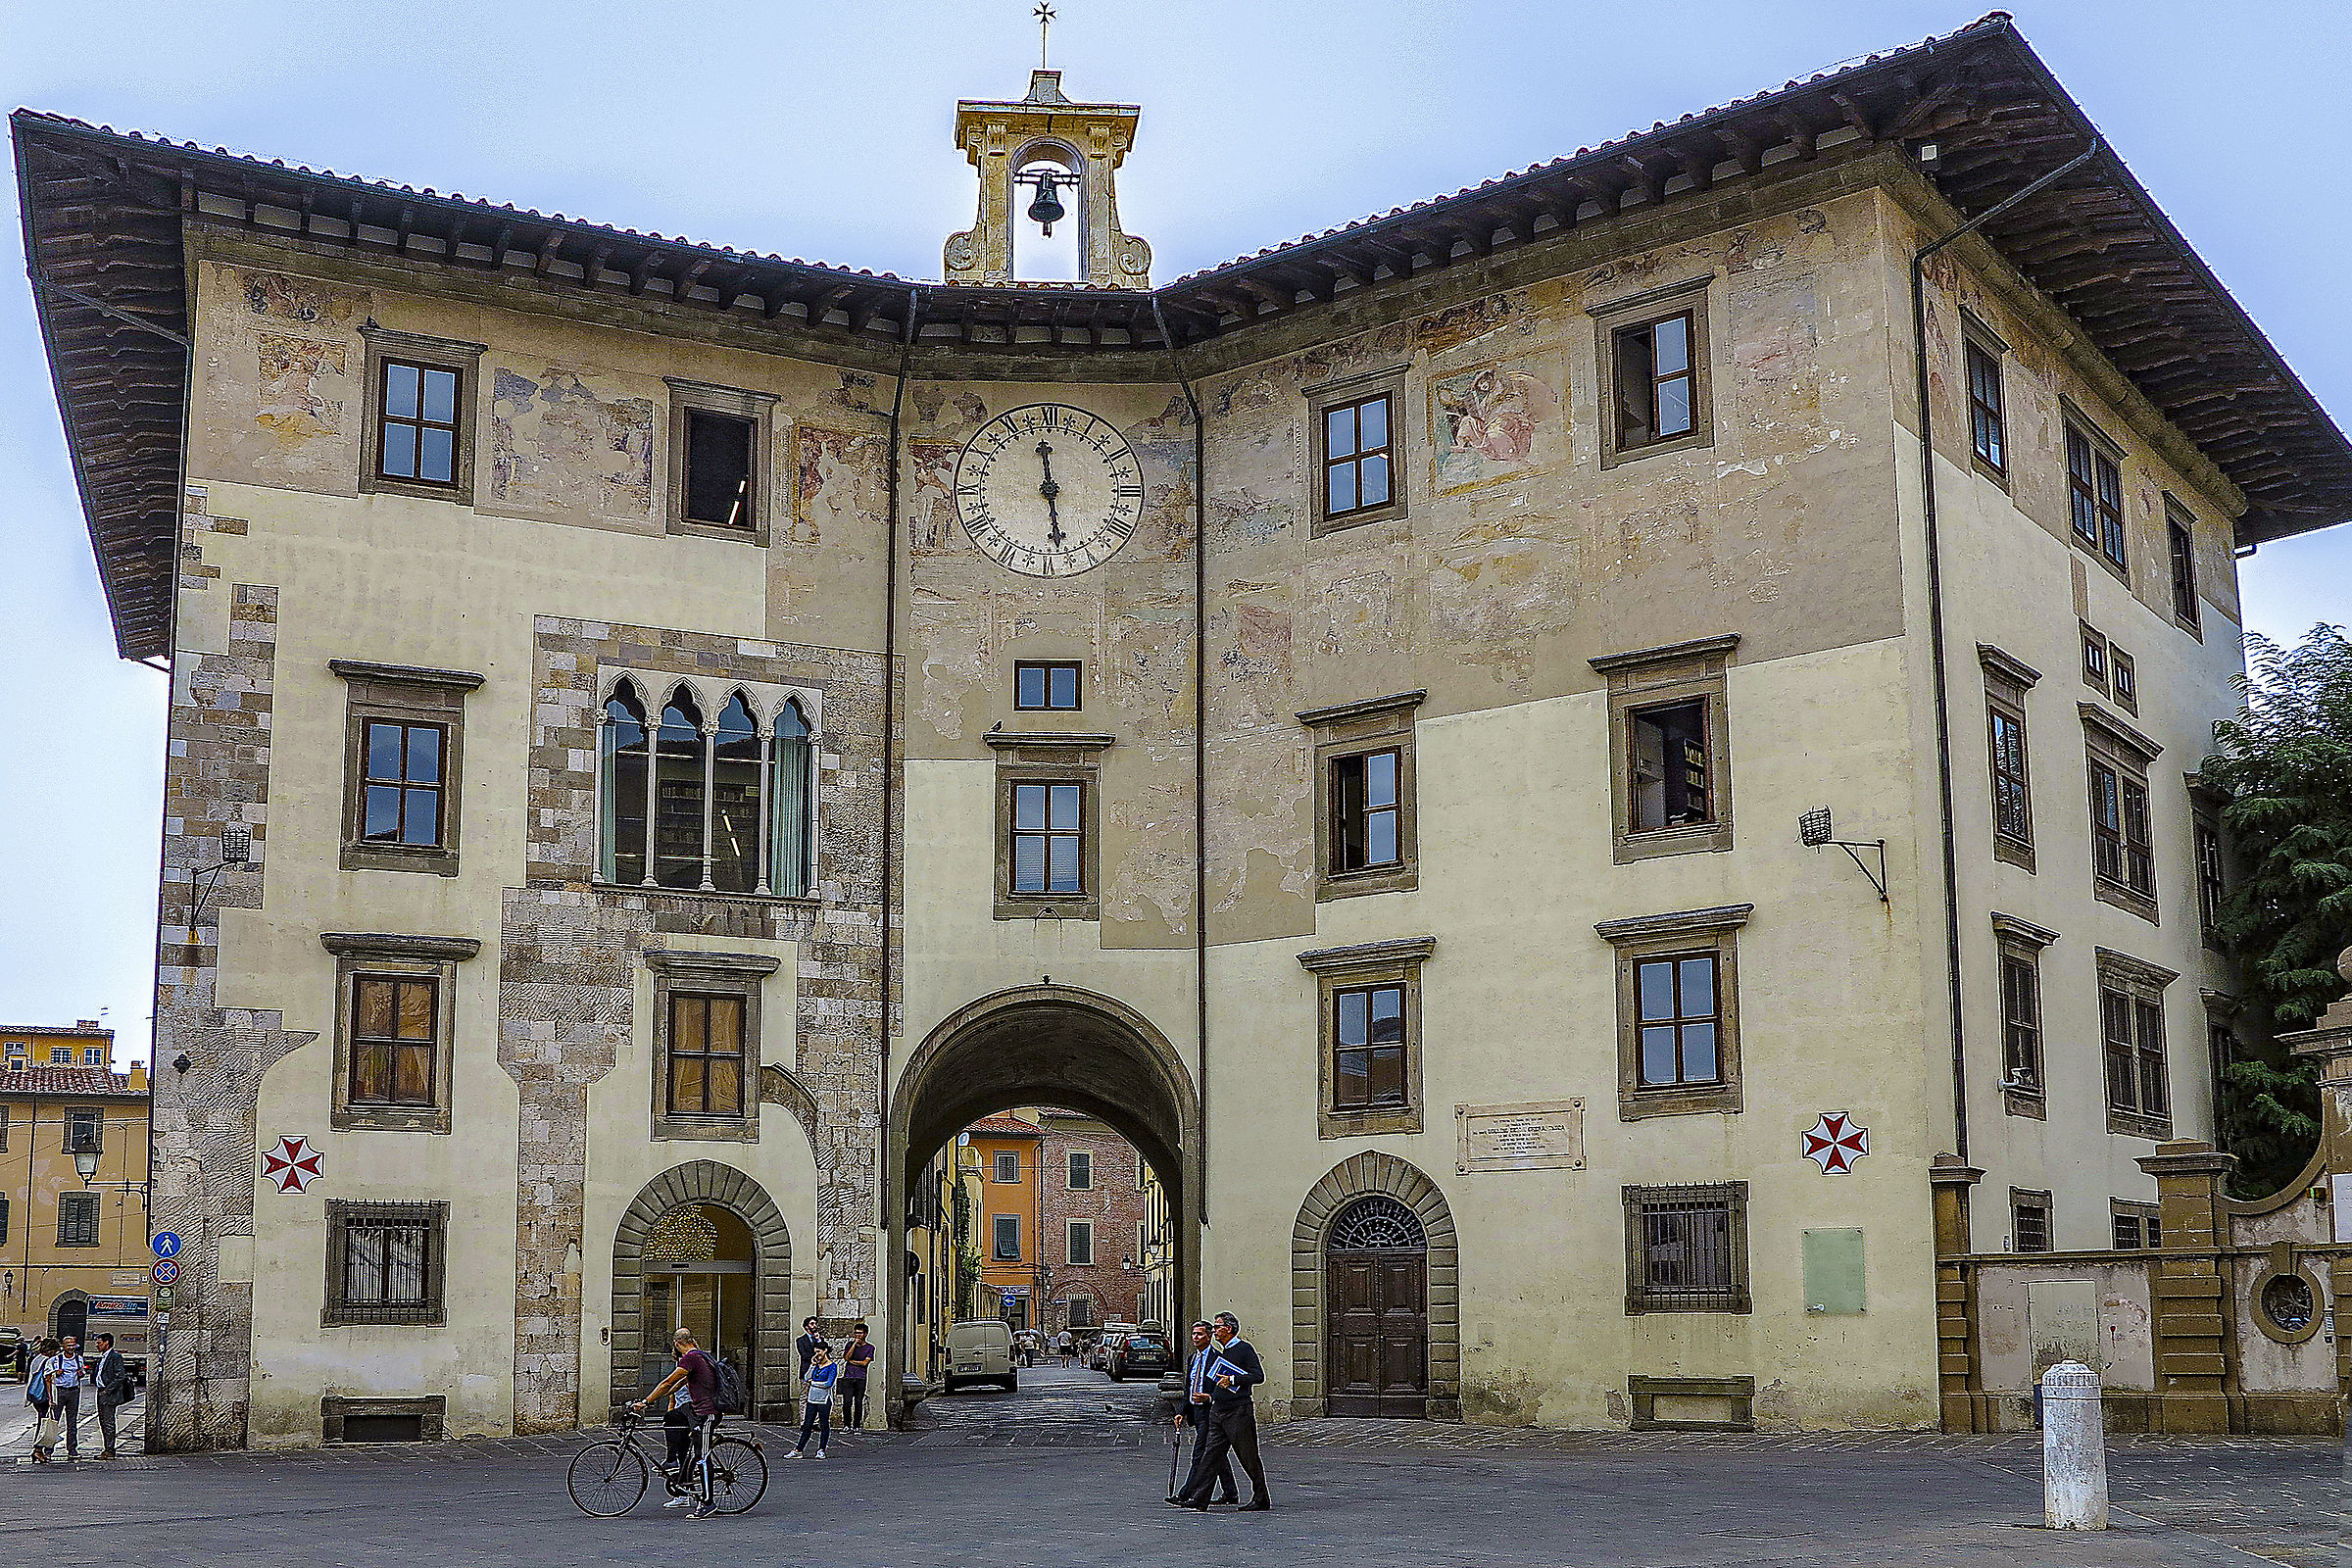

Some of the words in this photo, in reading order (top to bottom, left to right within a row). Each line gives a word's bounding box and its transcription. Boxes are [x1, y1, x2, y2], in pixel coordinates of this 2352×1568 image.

[1041, 406, 1057, 425] XII
[999, 416, 1019, 435] XI
[968, 444, 990, 461] X
[1109, 447, 1130, 462] II
[957, 483, 979, 495] IX
[1120, 485, 1141, 497] III
